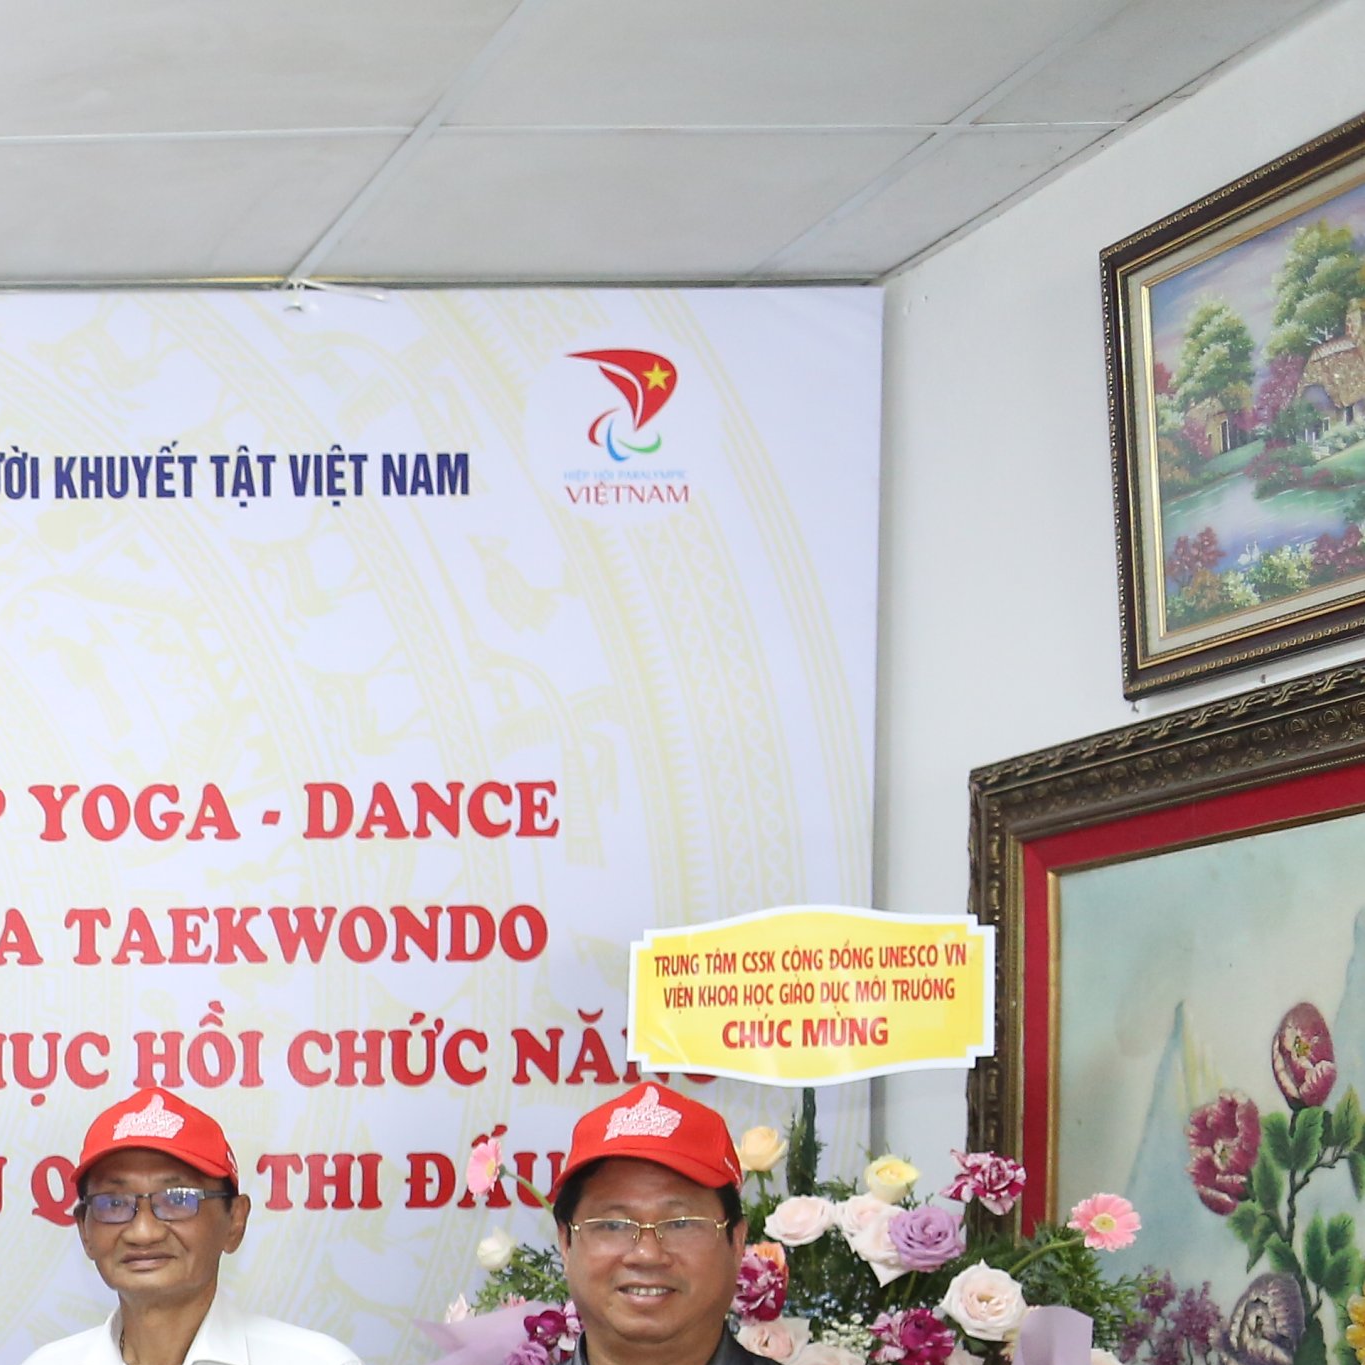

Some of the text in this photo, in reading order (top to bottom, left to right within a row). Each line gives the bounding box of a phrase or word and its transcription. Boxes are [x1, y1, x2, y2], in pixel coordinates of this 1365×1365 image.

[53, 445, 198, 499] KHUYẾT
[210, 442, 276, 510] TẬT
[288, 444, 373, 507] VIỆT
[379, 450, 469, 497] NAM
[27, 782, 242, 843] YOGA
[262, 809, 282, 826] -
[302, 779, 561, 841] DANCE
[64, 903, 549, 967] TAEKWONDO
[655, 954, 699, 977] TRUNG
[705, 948, 736, 974] TÂM
[742, 951, 775, 973] CSSK
[880, 944, 938, 968] UNESCO
[945, 944, 966, 966] VN
[663, 982, 693, 1014] VIỆN
[699, 985, 738, 1007] KHOA
[744, 984, 774, 1011] HỌC
[780, 978, 814, 1004] GIÁO
[820, 981, 849, 1008] DỤC
[856, 975, 886, 1002] MÔI
[132, 999, 265, 1094] HỒI
[286, 1011, 490, 1088] CHỨC
[722, 1010, 888, 1048] CHÚC MỪNG
[255, 1152, 383, 1212] THI
